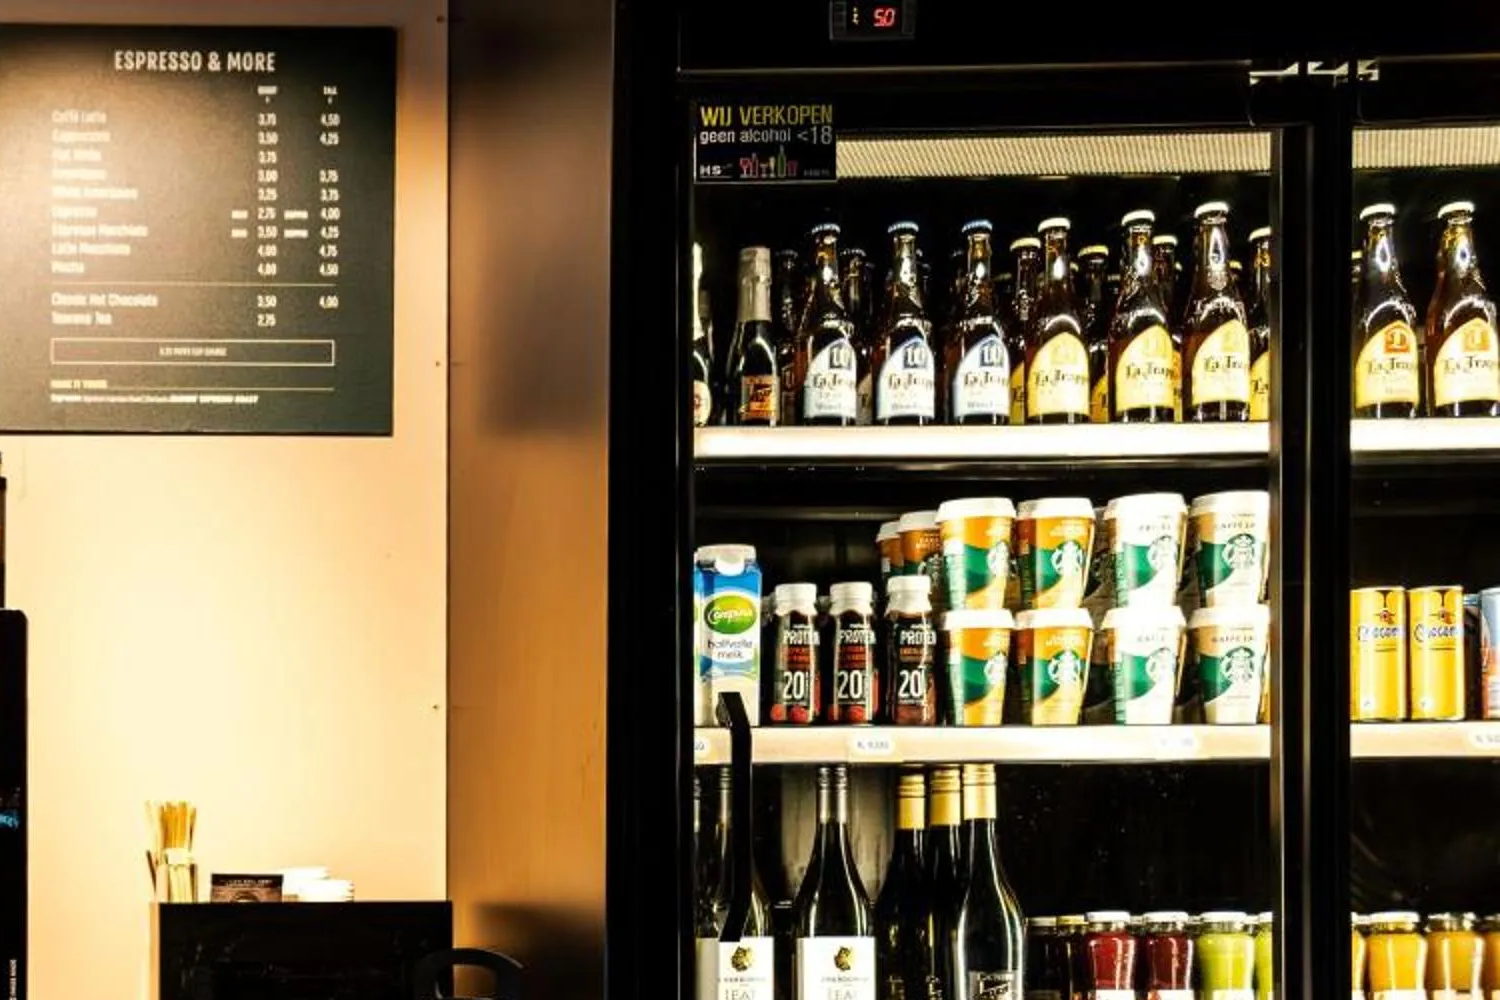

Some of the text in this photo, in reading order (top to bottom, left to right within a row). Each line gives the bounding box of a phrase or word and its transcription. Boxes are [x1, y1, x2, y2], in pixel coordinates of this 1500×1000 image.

[115, 51, 277, 73] ESPRESSO & MORE
[700, 104, 833, 127] WIJ VERKOPEN
[700, 125, 833, 145] geen alcohol <18
[782, 670, 803, 698] 20
[837, 670, 861, 698] 20
[898, 669, 921, 698] 20
